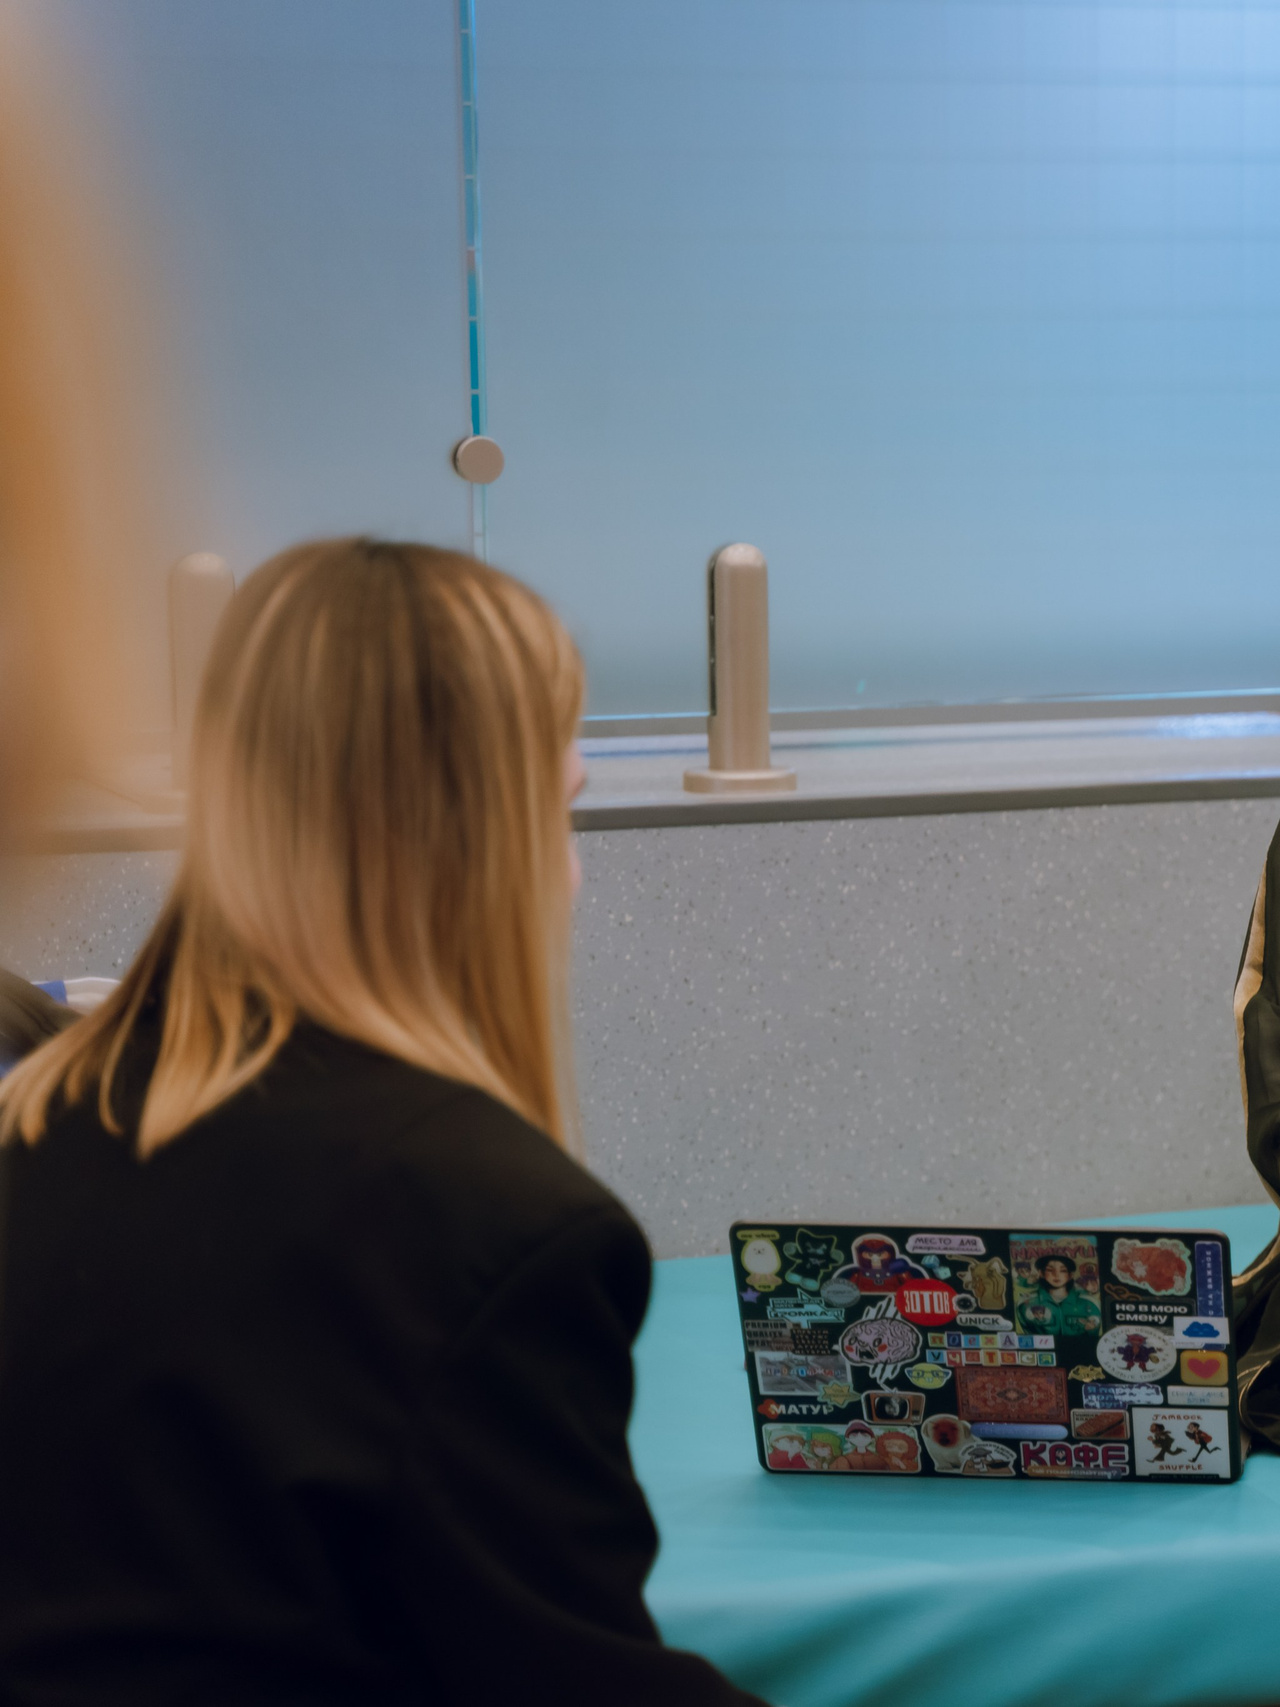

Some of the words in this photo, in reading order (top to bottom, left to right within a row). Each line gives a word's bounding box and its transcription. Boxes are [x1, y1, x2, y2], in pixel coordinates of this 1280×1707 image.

[914, 1236, 952, 1246] МЕСТО
[959, 1238, 977, 1246] ДЛЯ
[903, 1290, 950, 1314] ЗОТОВ
[959, 1317, 1000, 1325] UNICK
[770, 1404, 834, 1416] МАТУР
